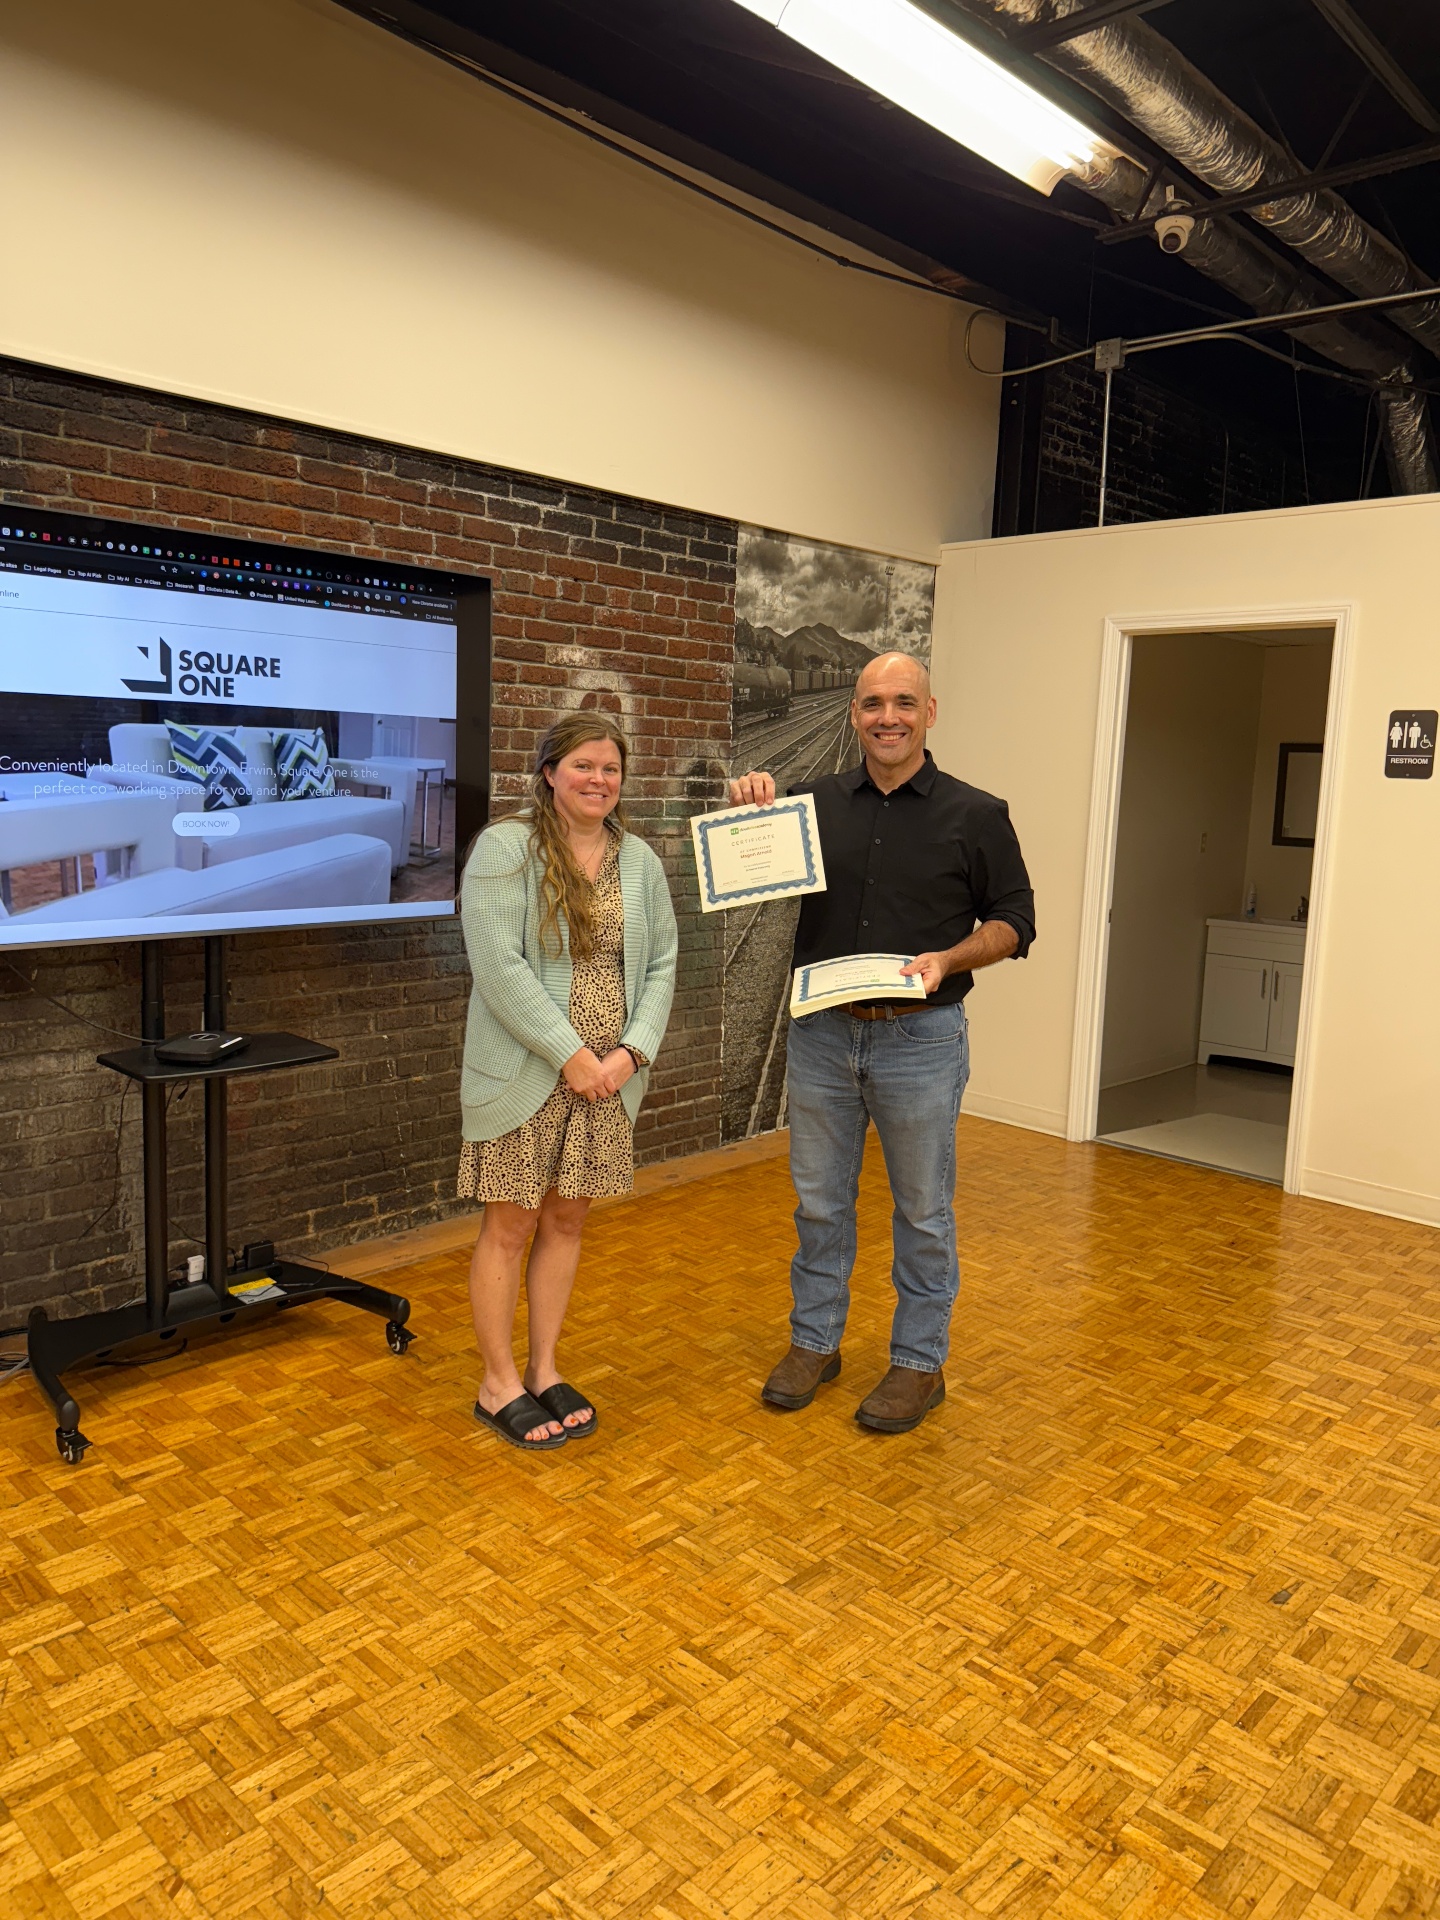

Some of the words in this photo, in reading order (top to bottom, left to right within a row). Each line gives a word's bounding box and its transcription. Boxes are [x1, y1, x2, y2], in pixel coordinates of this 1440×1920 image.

[0, 589, 20, 598] nline
[178, 649, 281, 678] SQUARE
[178, 674, 235, 698] ONE
[0, 755, 95, 776] Conveniently
[99, 758, 148, 774] located
[152, 760, 164, 774] in
[168, 759, 236, 775] Downtown
[240, 761, 277, 778] Erwin,
[281, 763, 320, 780] Square
[323, 764, 347, 778] One
[350, 766, 359, 778] is
[359, 766, 379, 779] the
[1391, 757, 1428, 765] RESTROOM
[34, 779, 87, 799] perfect
[90, 784, 107, 795] co
[170, 785, 206, 800] space
[209, 783, 227, 796] for
[230, 787, 253, 800] you
[256, 784, 278, 797] and
[280, 787, 306, 801] your
[309, 788, 354, 798] venture.
[182, 819, 206, 828] BOOK
[731, 834, 775, 847] CERTIFICATE
